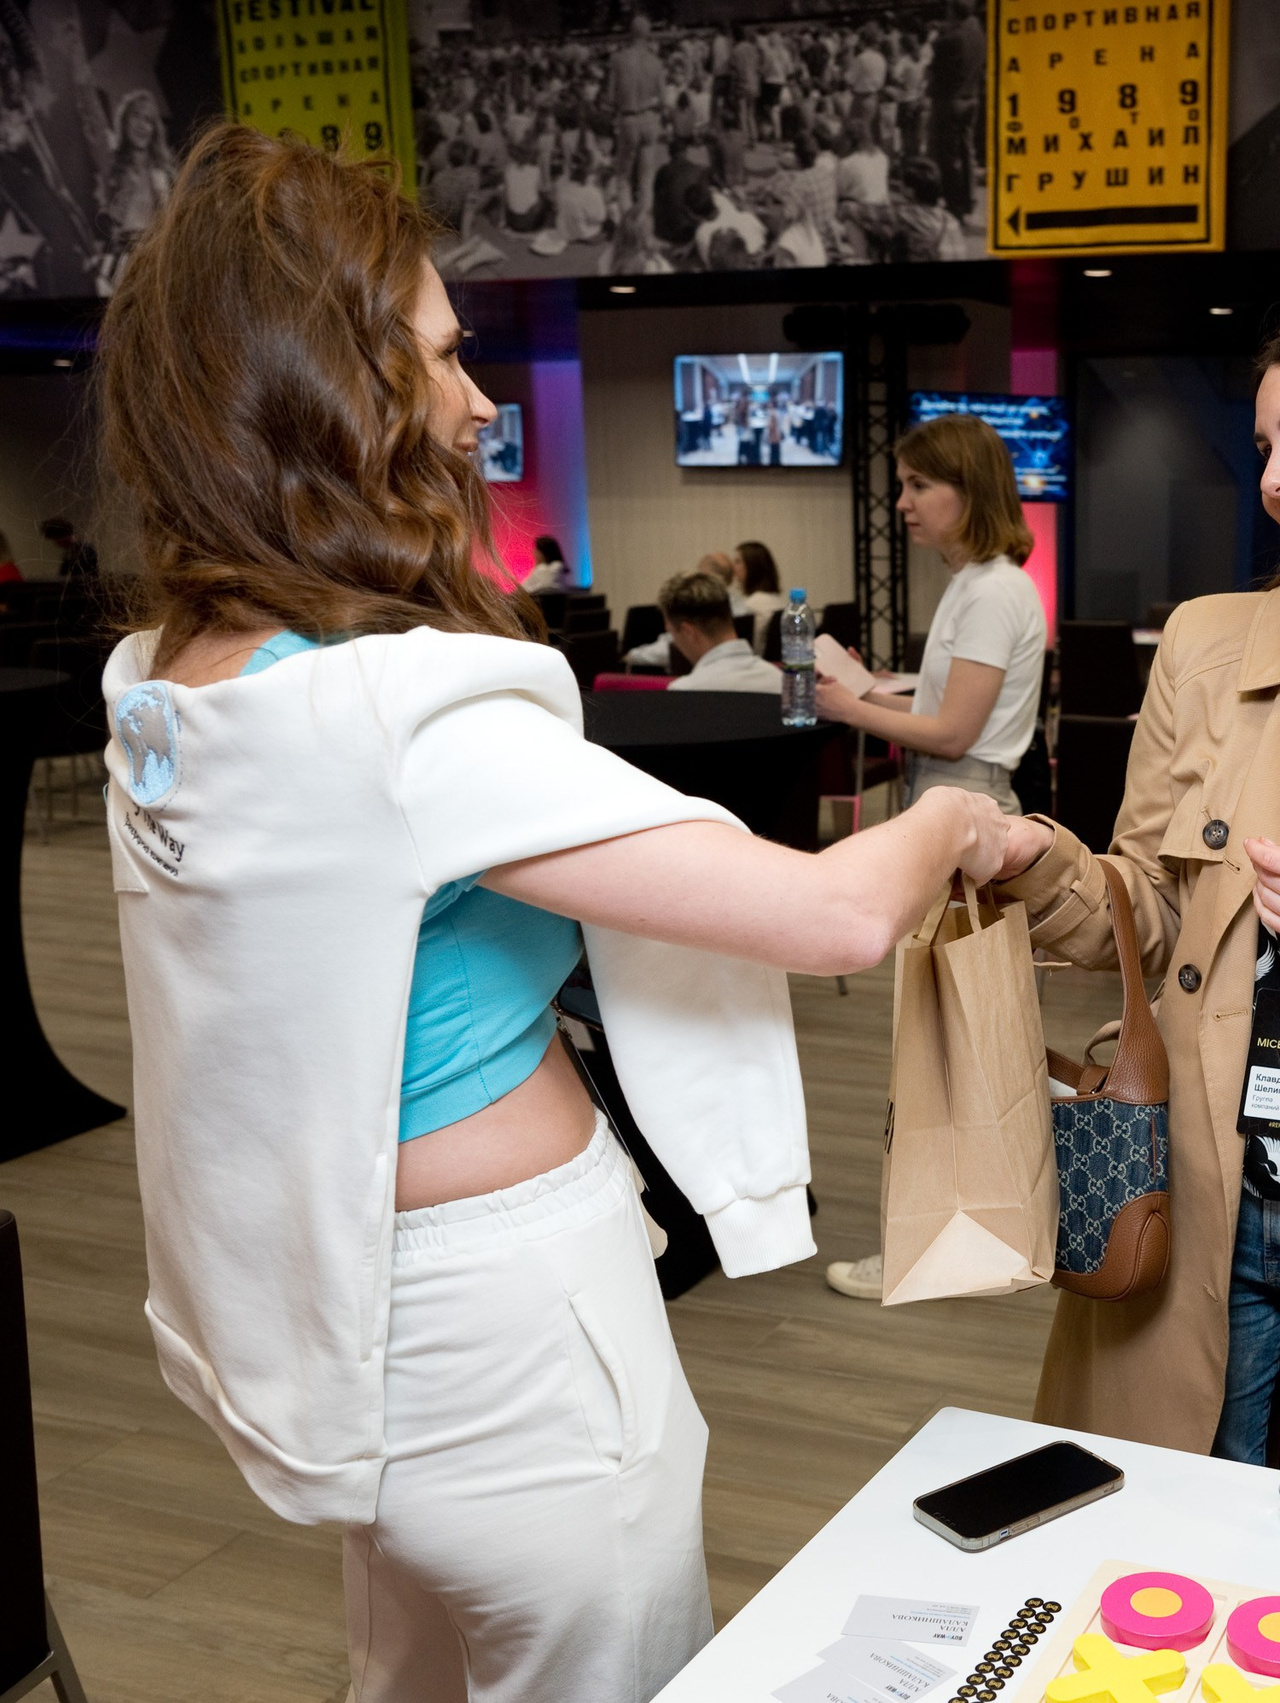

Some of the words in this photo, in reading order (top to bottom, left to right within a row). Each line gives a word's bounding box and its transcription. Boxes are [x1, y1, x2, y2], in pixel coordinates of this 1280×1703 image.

[1006, 1, 1202, 35] СПОРТИВНАЯ
[1006, 41, 1200, 73] АРЕНА
[1007, 79, 1200, 118] 1989
[1006, 126, 1200, 155] МИХАИЛ
[1006, 164, 1200, 193] ГРУШИН
